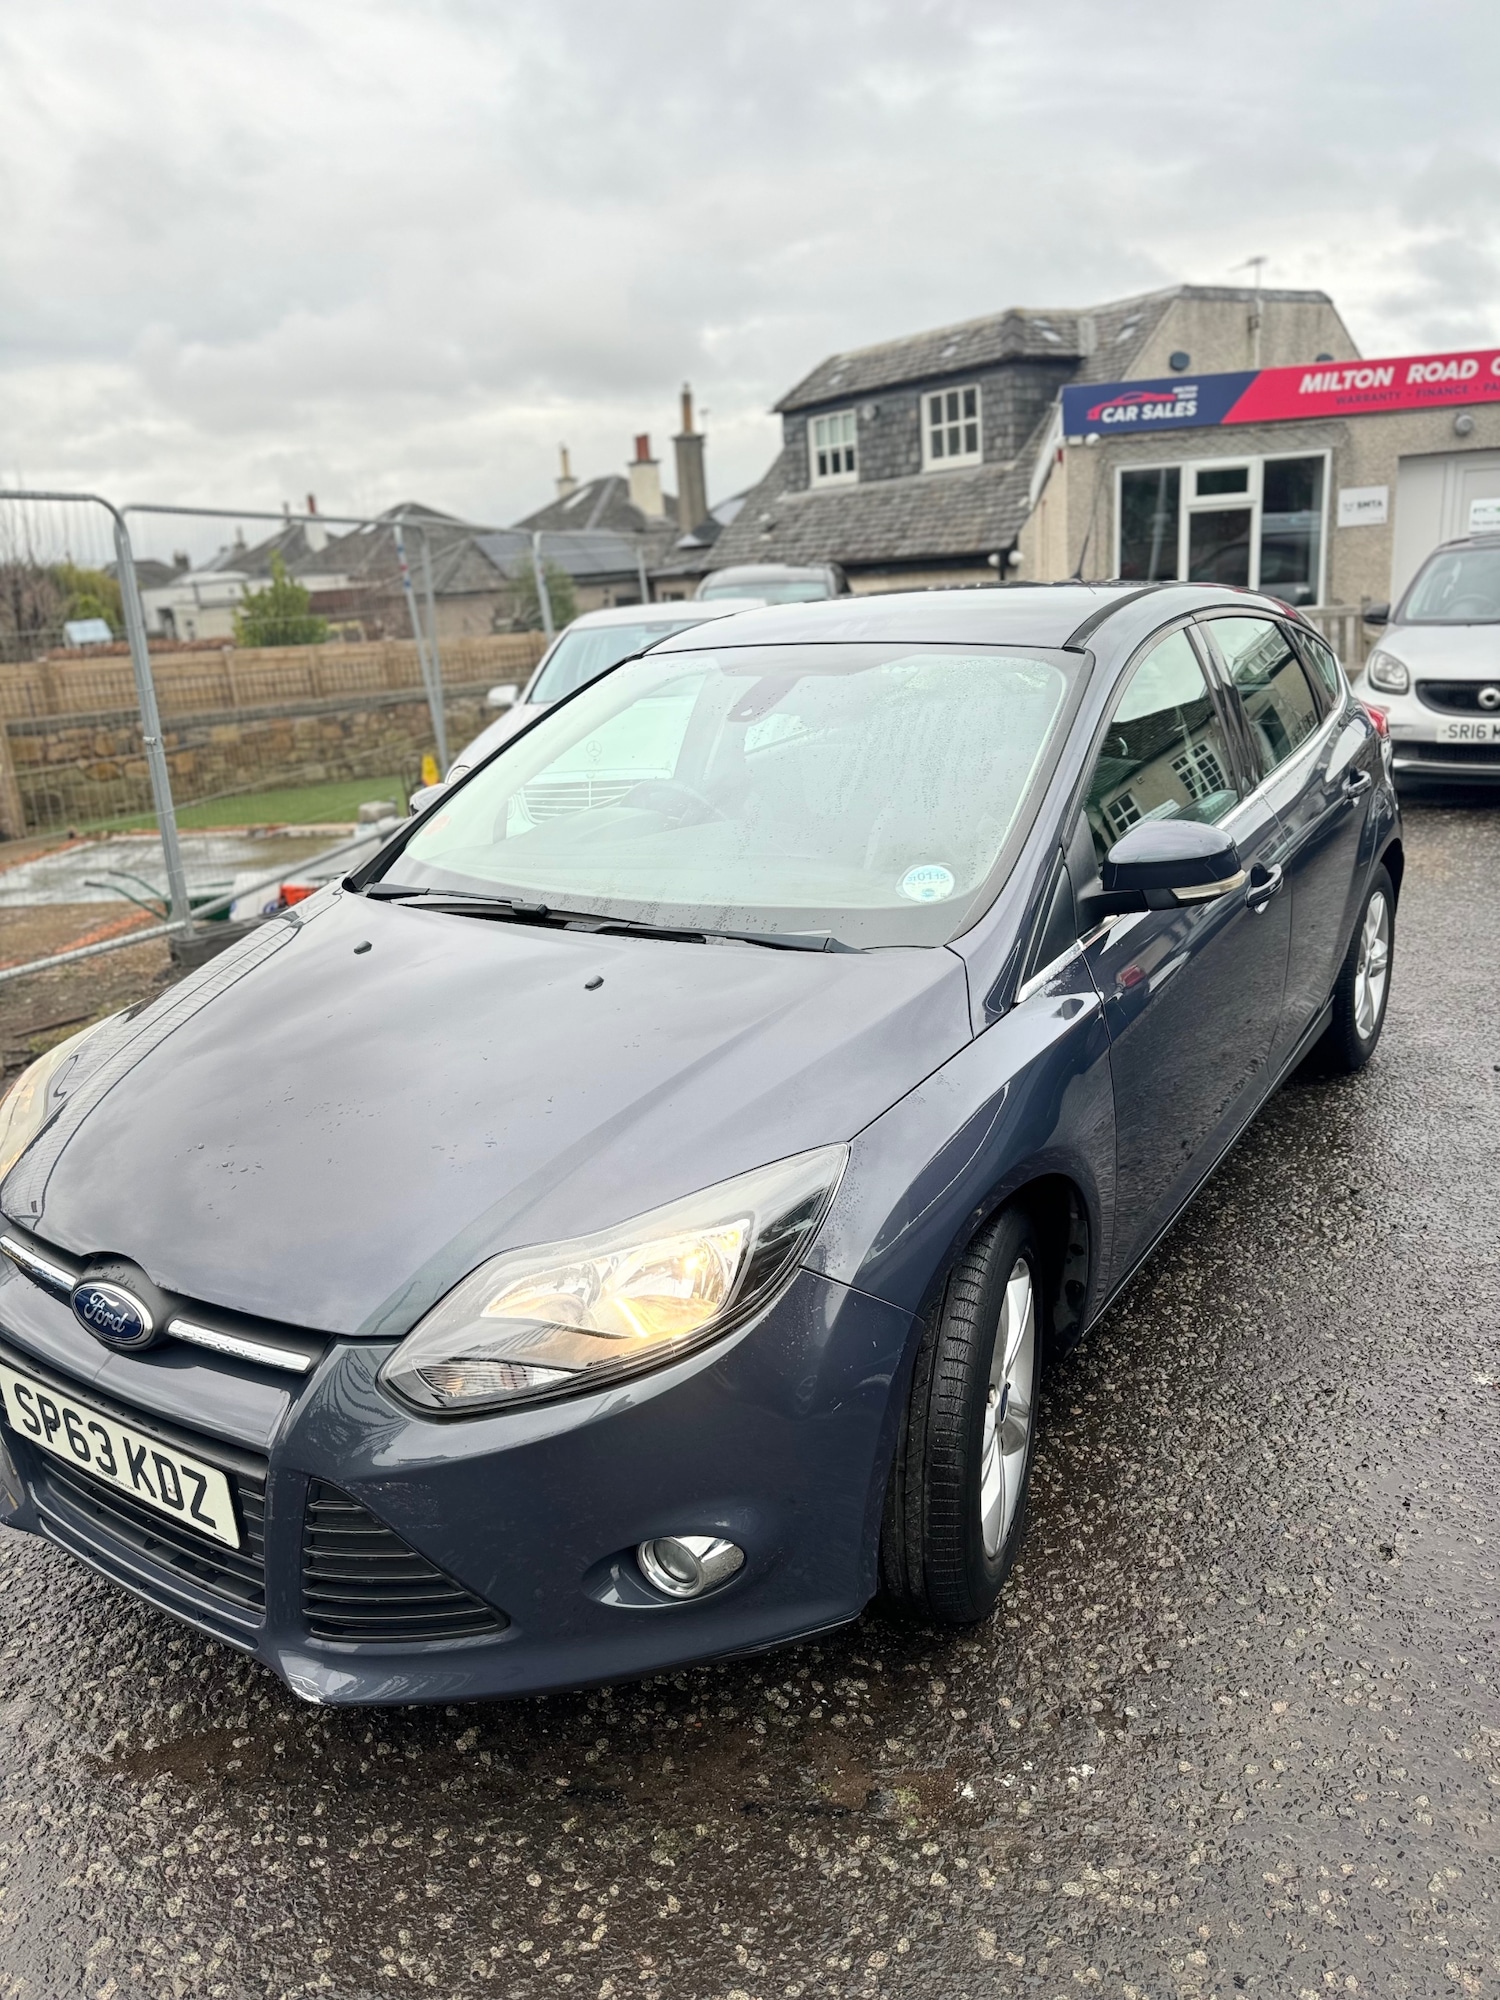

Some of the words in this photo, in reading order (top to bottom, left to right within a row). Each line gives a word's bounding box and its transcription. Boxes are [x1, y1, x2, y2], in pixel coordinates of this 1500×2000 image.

[1299, 366, 1395, 394] MILTON
[1406, 359, 1479, 385] ROAD
[1336, 391, 1401, 405] WARRANTY
[1415, 383, 1468, 398] FINANCE
[1101, 405, 1139, 423] CAR
[1141, 401, 1197, 420] SALES
[1448, 723, 1487, 739] SR16
[83, 1292, 129, 1334] Ford
[14, 1382, 117, 1477] SP63
[123, 1436, 217, 1530] KDZ
